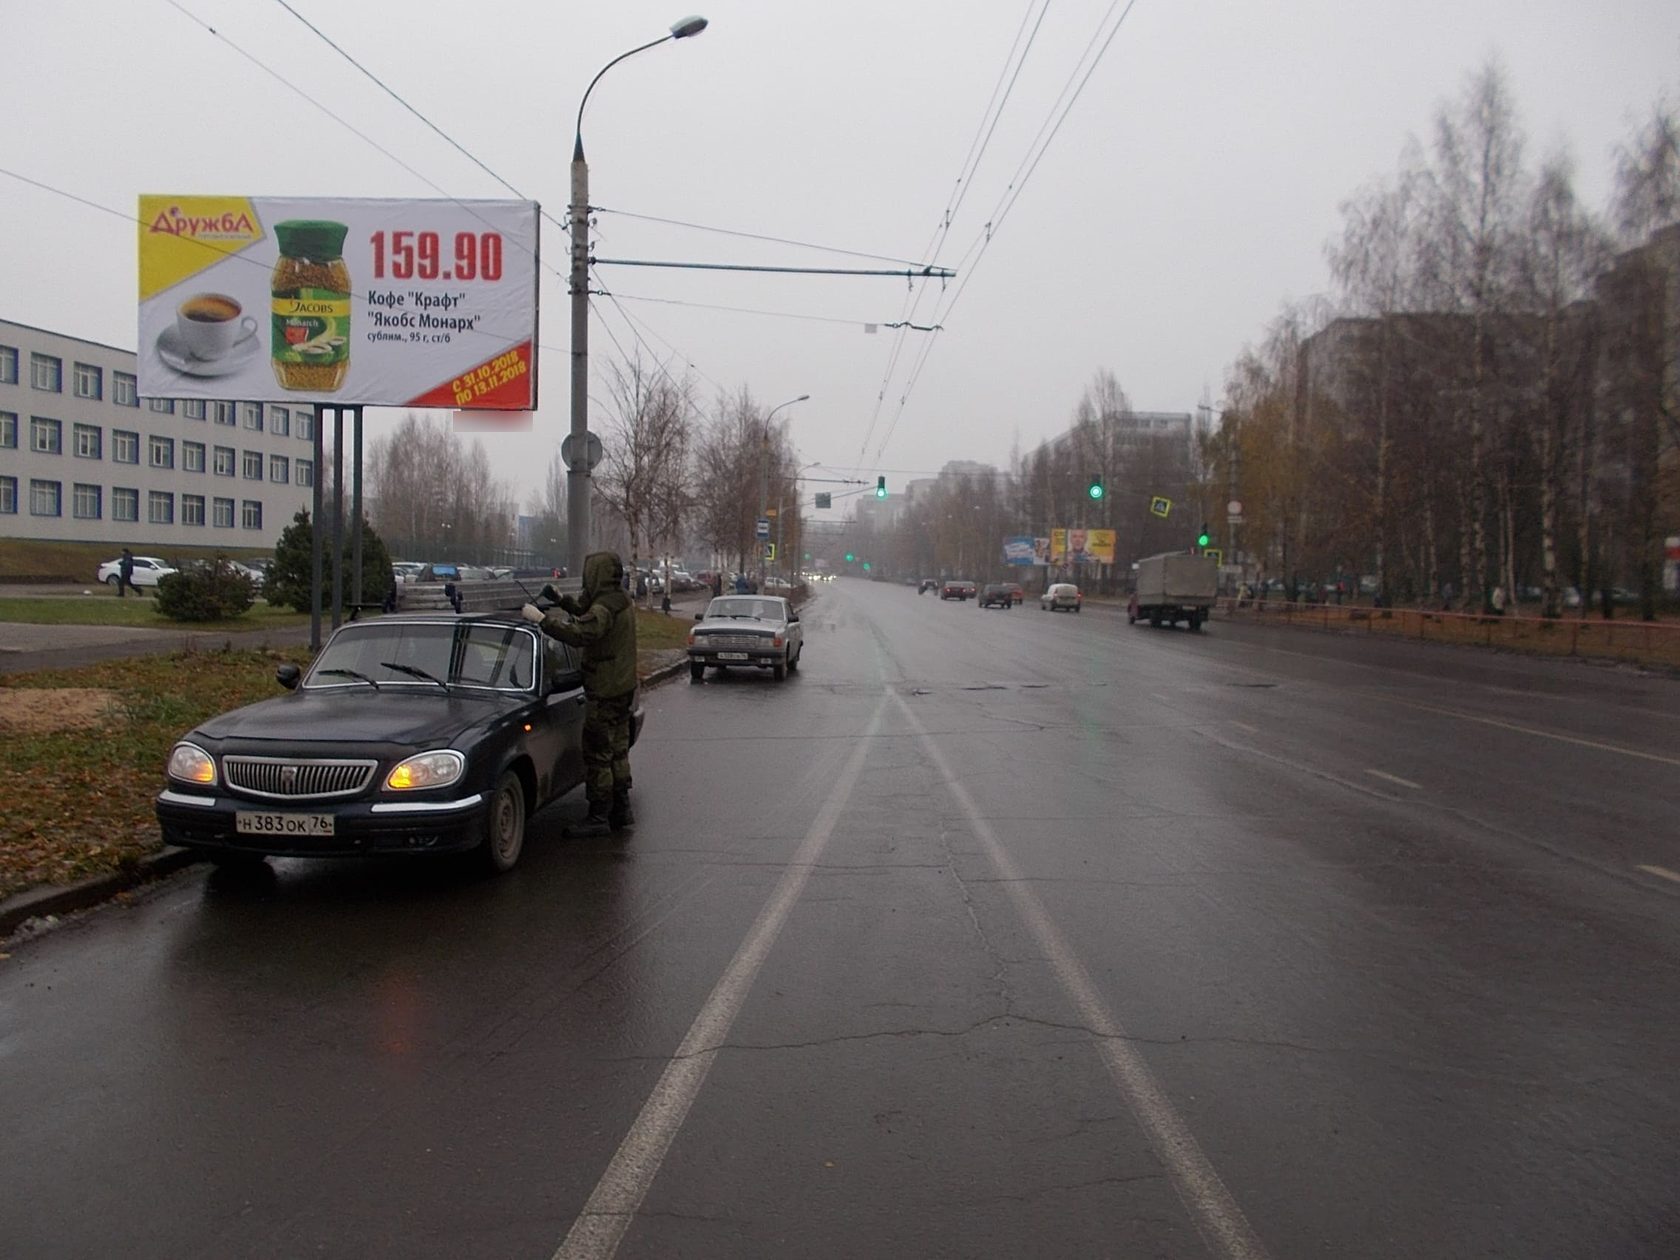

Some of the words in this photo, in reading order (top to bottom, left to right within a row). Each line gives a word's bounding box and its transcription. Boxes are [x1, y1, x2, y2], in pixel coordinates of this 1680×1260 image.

[370, 230, 502, 281] 159.90
[289, 301, 334, 314] JACOBS
[368, 290, 404, 309] Кофе
[408, 291, 466, 312] "Крафт"
[367, 311, 416, 328] "Якобс
[419, 313, 481, 333] Монарх"
[410, 331, 421, 342] 95
[463, 350, 519, 387] 31.10.2018
[455, 389, 473, 406] ПО
[474, 360, 527, 397] 13.11.2018
[311, 816, 328, 829] 76
